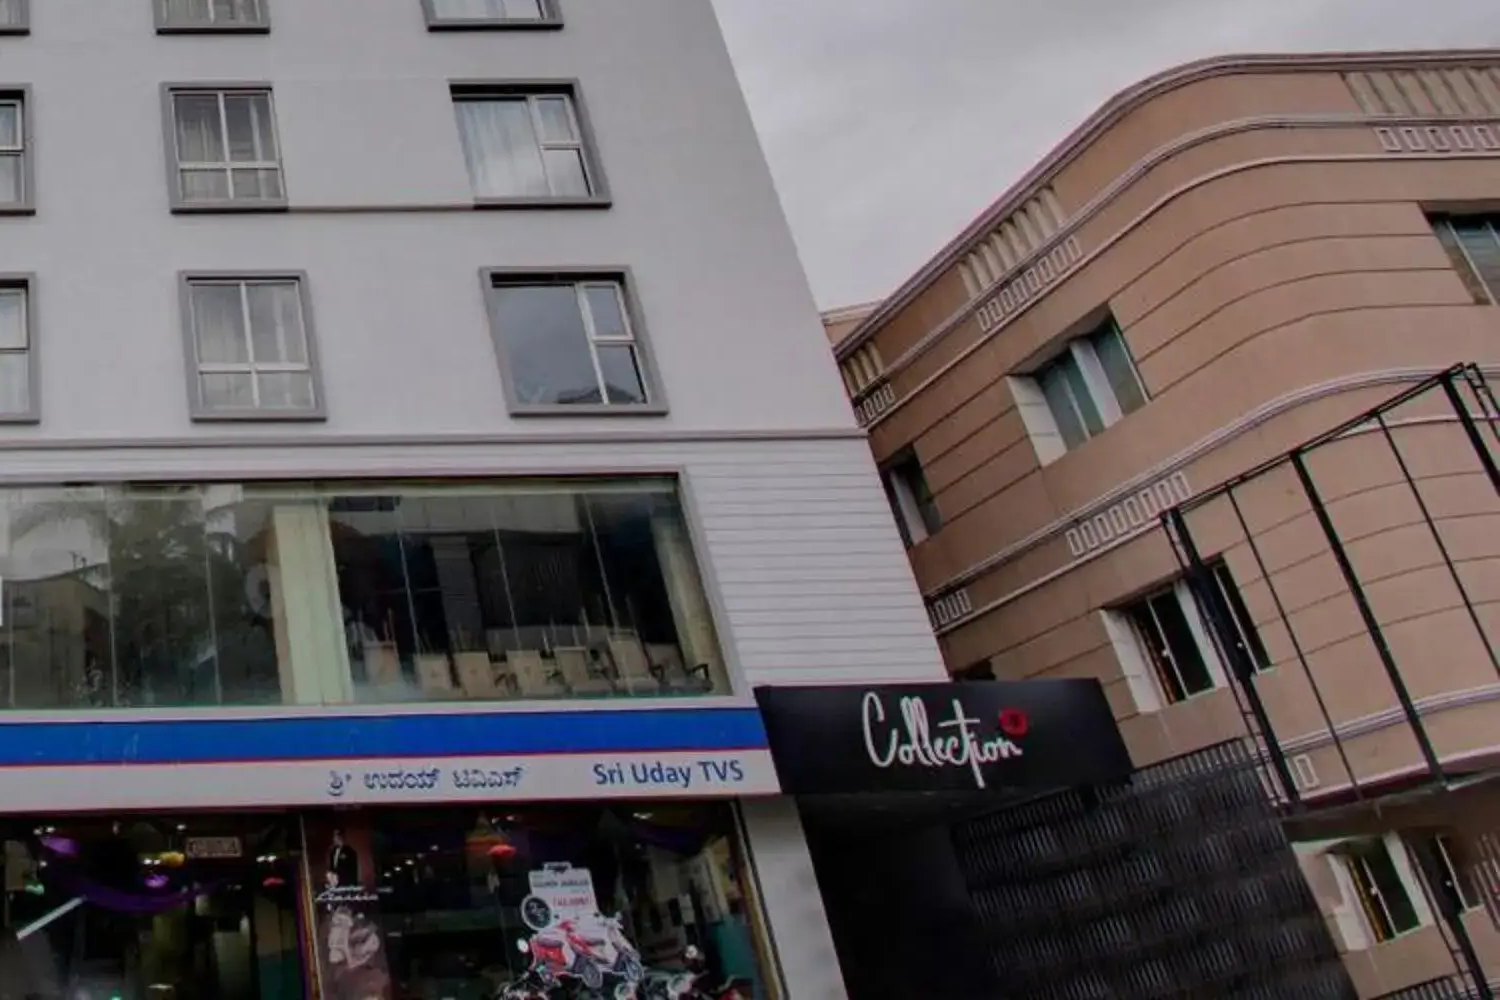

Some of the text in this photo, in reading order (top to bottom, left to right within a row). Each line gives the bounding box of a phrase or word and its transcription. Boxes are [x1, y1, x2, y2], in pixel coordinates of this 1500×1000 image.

[862, 691, 1023, 789] Collection
[593, 759, 744, 788] Sri Uday TVS
